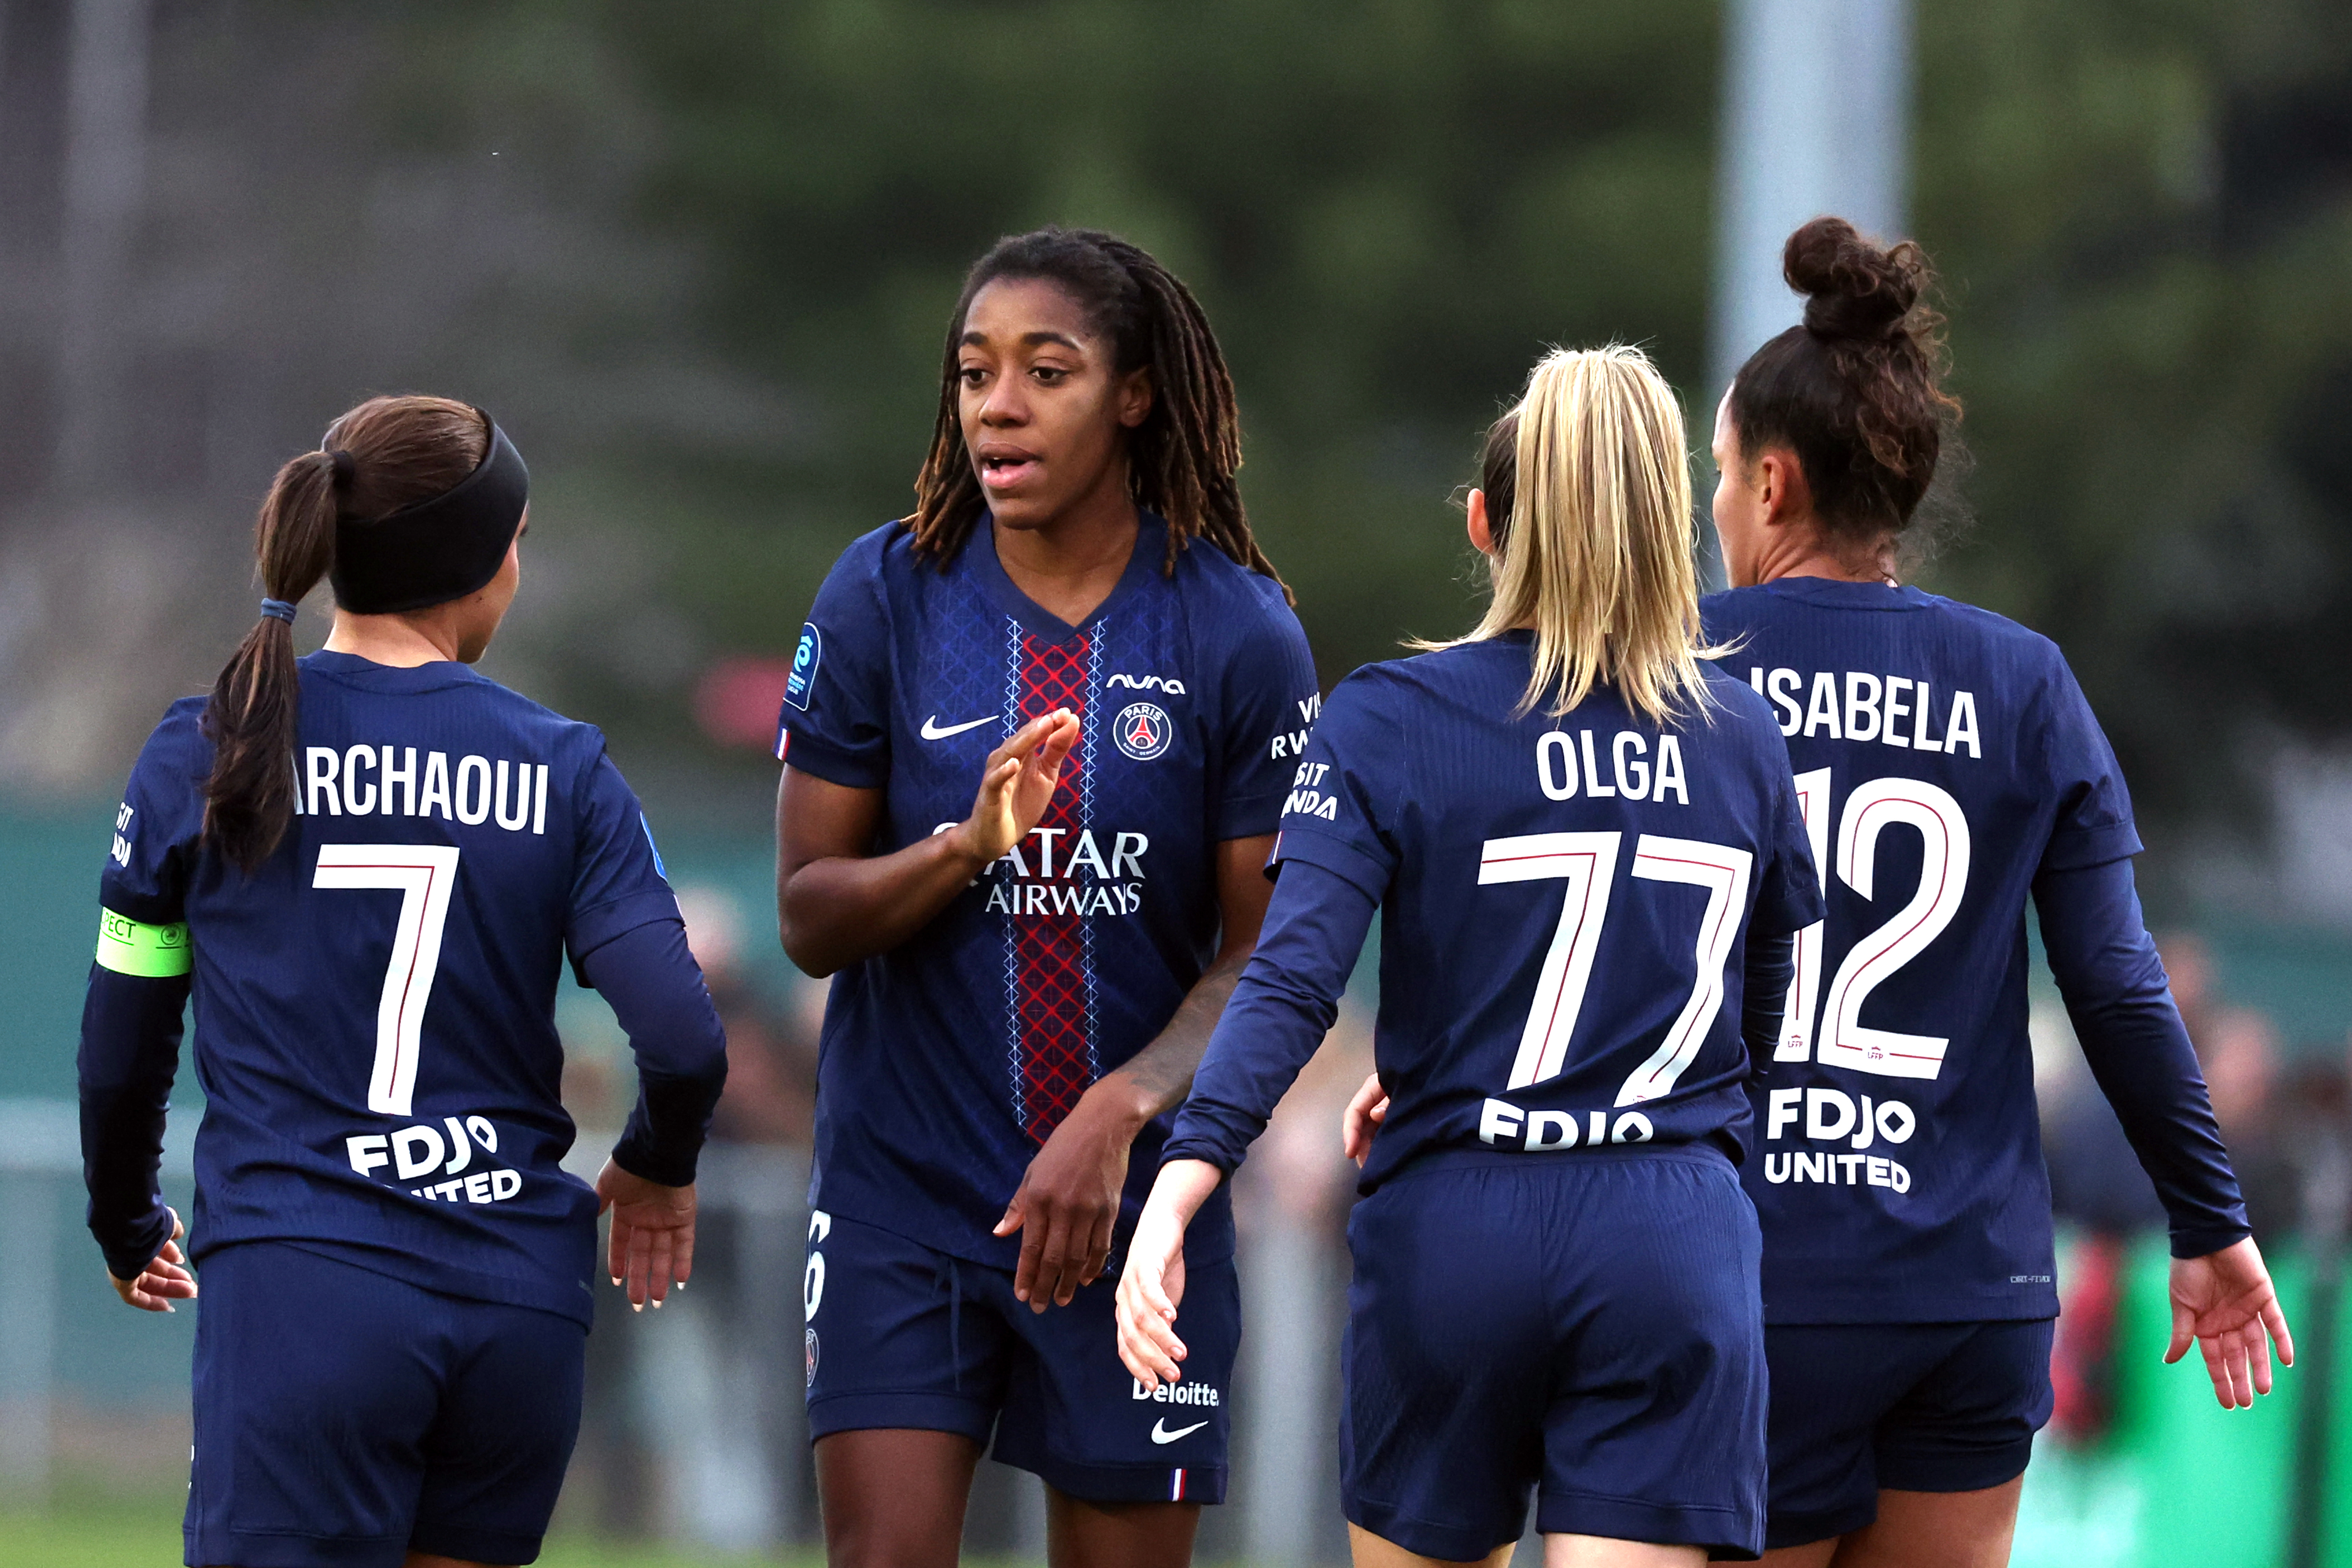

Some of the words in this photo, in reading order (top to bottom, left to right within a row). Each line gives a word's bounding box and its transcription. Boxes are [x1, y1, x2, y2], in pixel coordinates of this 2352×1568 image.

[1106, 674, 1186, 694] nuna
[1124, 706, 1162, 721] PARIS
[291, 744, 548, 835] RCHAOUI
[1294, 762, 1330, 788] SIT
[1537, 730, 1689, 805] OLGA
[1281, 790, 1337, 821] NDA
[933, 822, 1149, 887] ATAR
[102, 909, 136, 938] PECT
[985, 882, 1143, 916] AIRWAYS
[1773, 766, 1971, 1079] 12
[312, 844, 460, 1116] 7
[1478, 831, 1753, 1107] 77
[346, 1115, 497, 1179] FDJO
[1767, 1087, 1915, 1149] FDJO
[1765, 1152, 1910, 1193] UNITED
